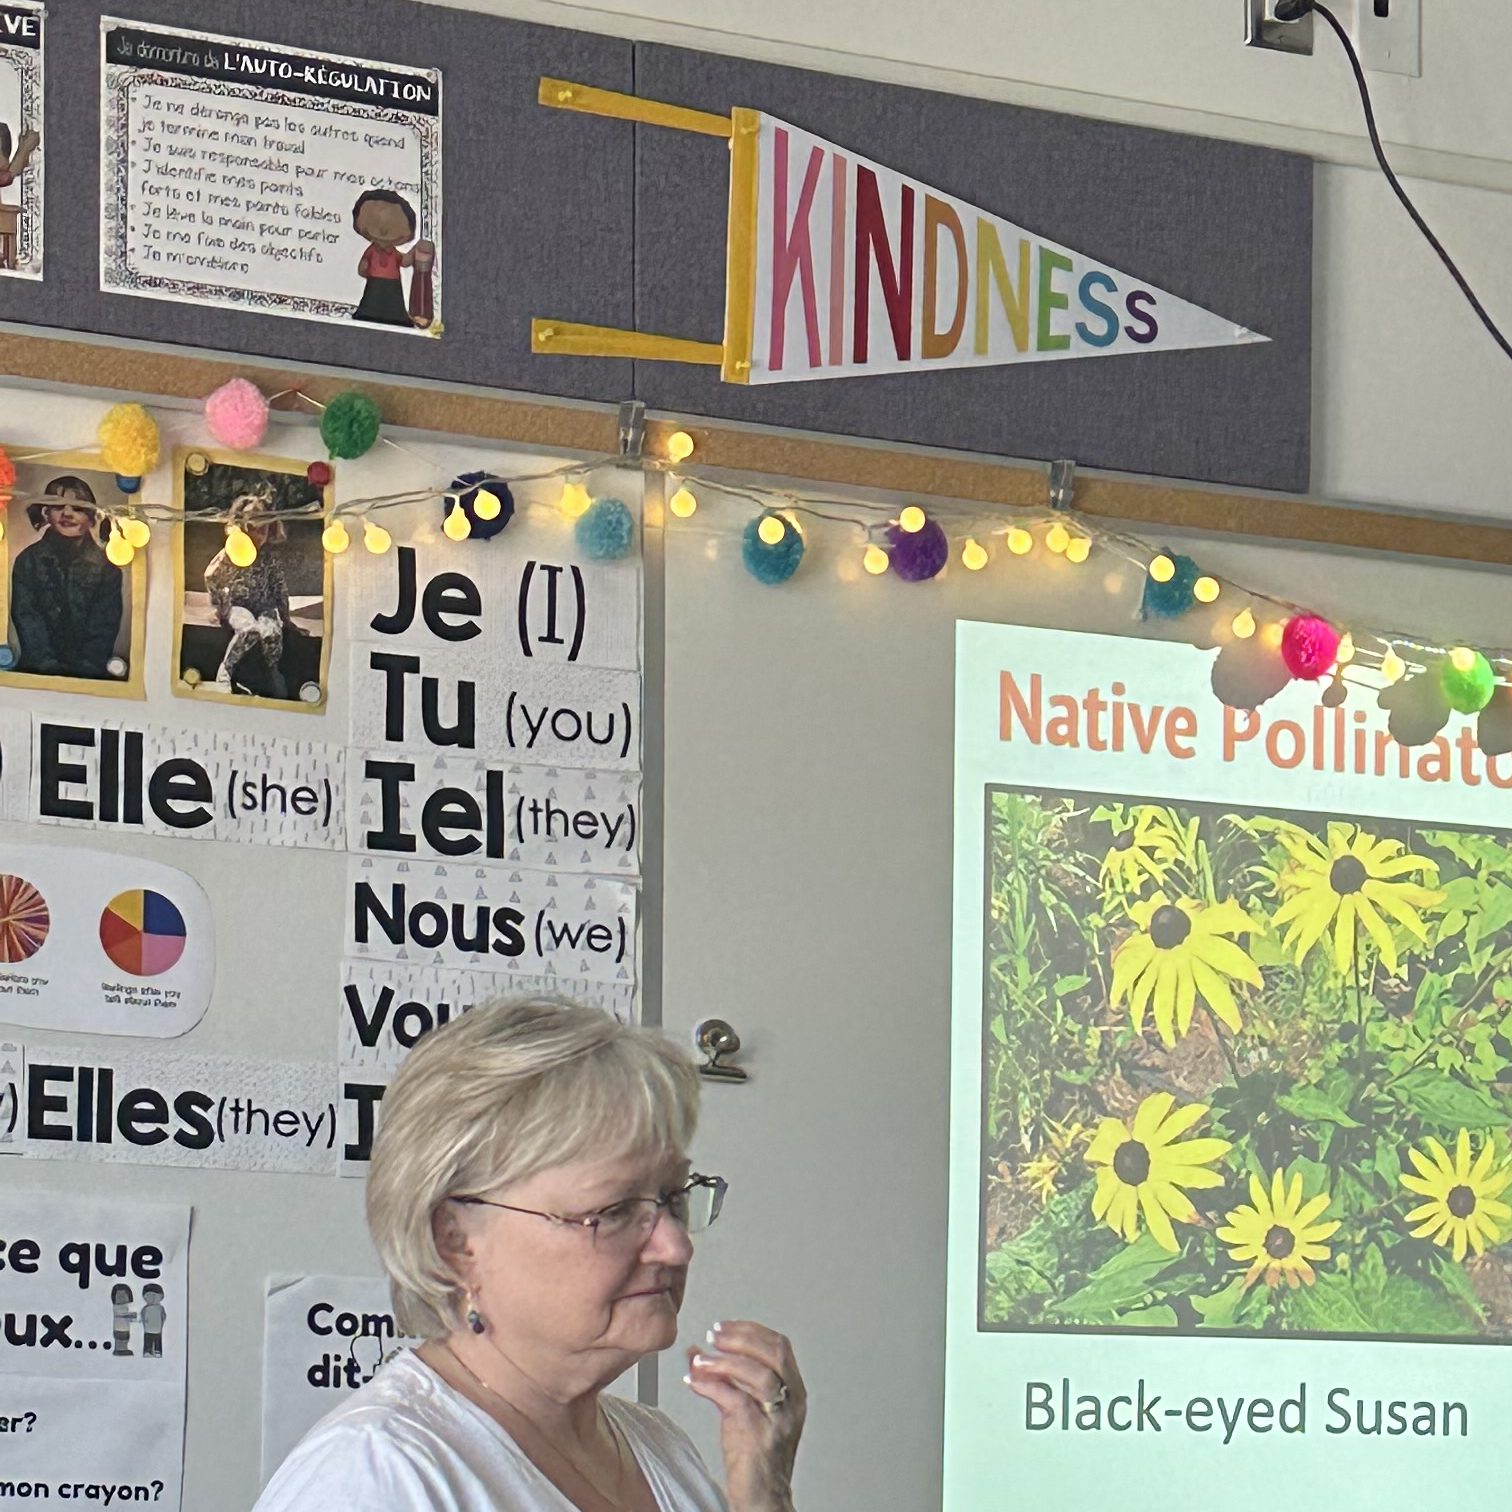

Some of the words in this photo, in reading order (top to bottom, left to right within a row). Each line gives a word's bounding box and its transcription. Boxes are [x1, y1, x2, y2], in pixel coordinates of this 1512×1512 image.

[768, 126, 1159, 372] KINDNESS
[370, 547, 482, 643] Je
[517, 560, 587, 661] (I)
[369, 651, 477, 750] Tu
[505, 691, 632, 758] (you)
[1000, 669, 1199, 761] Native
[39, 722, 214, 829] Elle
[228, 766, 332, 828] (she)
[364, 759, 506, 860] Iel
[515, 794, 637, 852] (they)
[353, 882, 525, 958] Nous
[534, 910, 628, 964] (we)
[27, 1064, 215, 1150] Elles
[215, 1096, 337, 1149] (they)
[59, 1242, 163, 1290] que
[307, 1302, 396, 1338] Com
[1025, 1377, 1306, 1444] Black-eyed
[1325, 1387, 1469, 1437] Susan
[58, 1480, 164, 1506] crayon?
